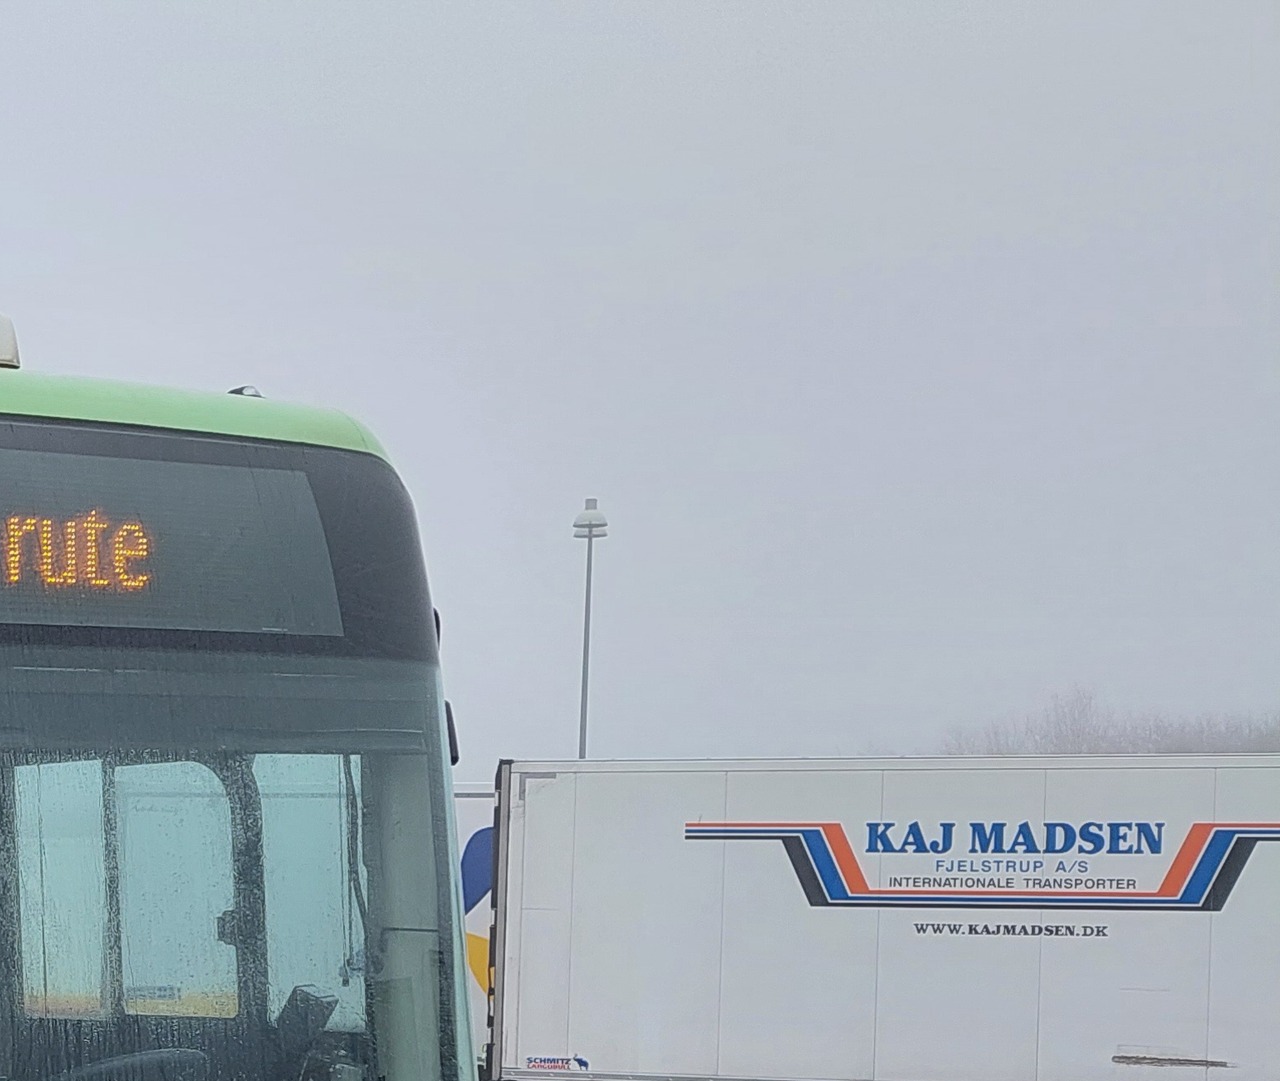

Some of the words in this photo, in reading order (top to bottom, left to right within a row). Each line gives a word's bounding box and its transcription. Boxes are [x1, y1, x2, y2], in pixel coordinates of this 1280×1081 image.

[7, 509, 150, 588] rute
[865, 821, 955, 854] KAJ
[969, 821, 1165, 854] MADSEN
[935, 860, 1044, 873] FJELSTRUP
[1056, 859, 1089, 873] A/S
[888, 876, 1017, 890] INTERNATIONALE
[1023, 877, 1137, 891] TRANSPORTER
[913, 922, 1108, 937] WWW.KAJMADSEN.DK
[526, 1057, 571, 1065] SCHMITZ
